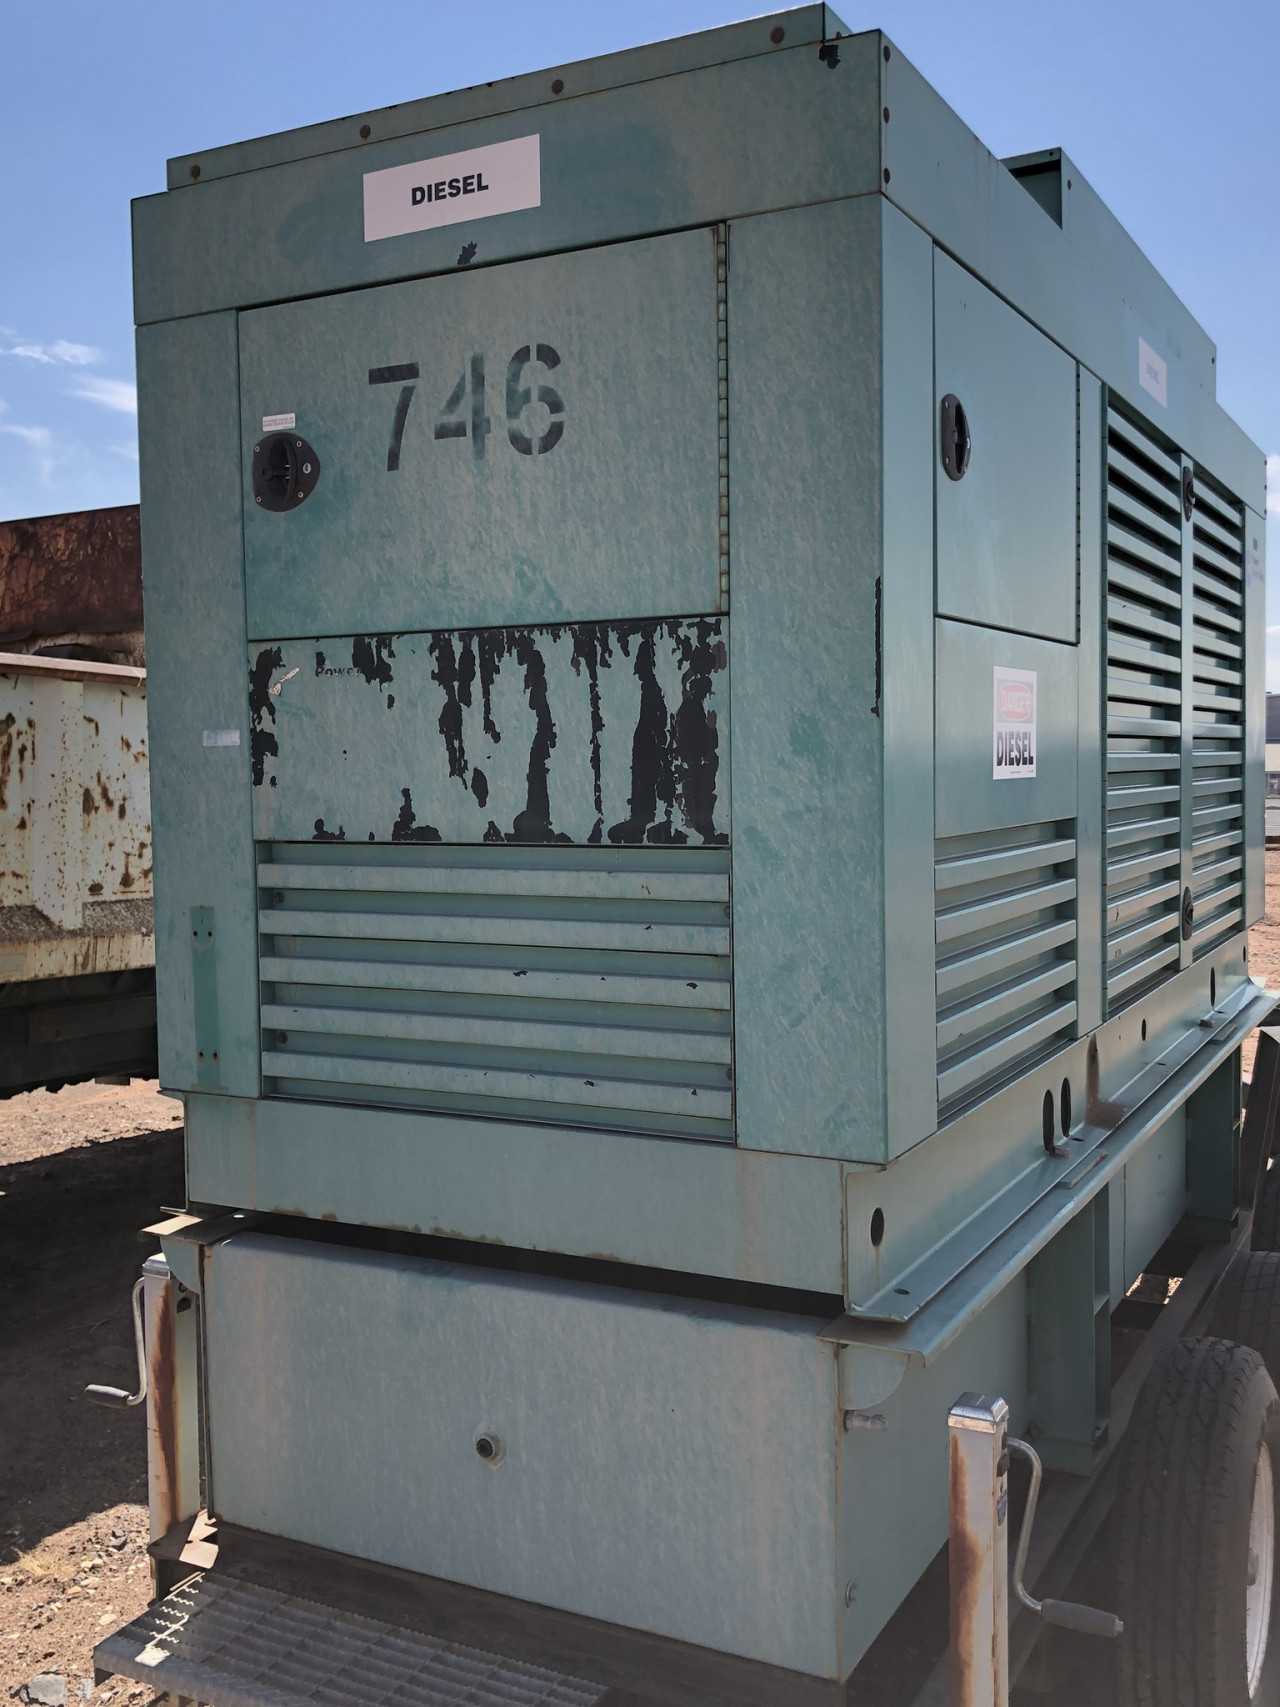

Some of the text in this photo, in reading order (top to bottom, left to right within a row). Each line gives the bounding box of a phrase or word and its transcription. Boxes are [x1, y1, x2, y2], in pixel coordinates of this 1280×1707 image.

[411, 173, 489, 206] DIESEL
[368, 343, 565, 472] 746
[996, 730, 1034, 766] DIESEL
